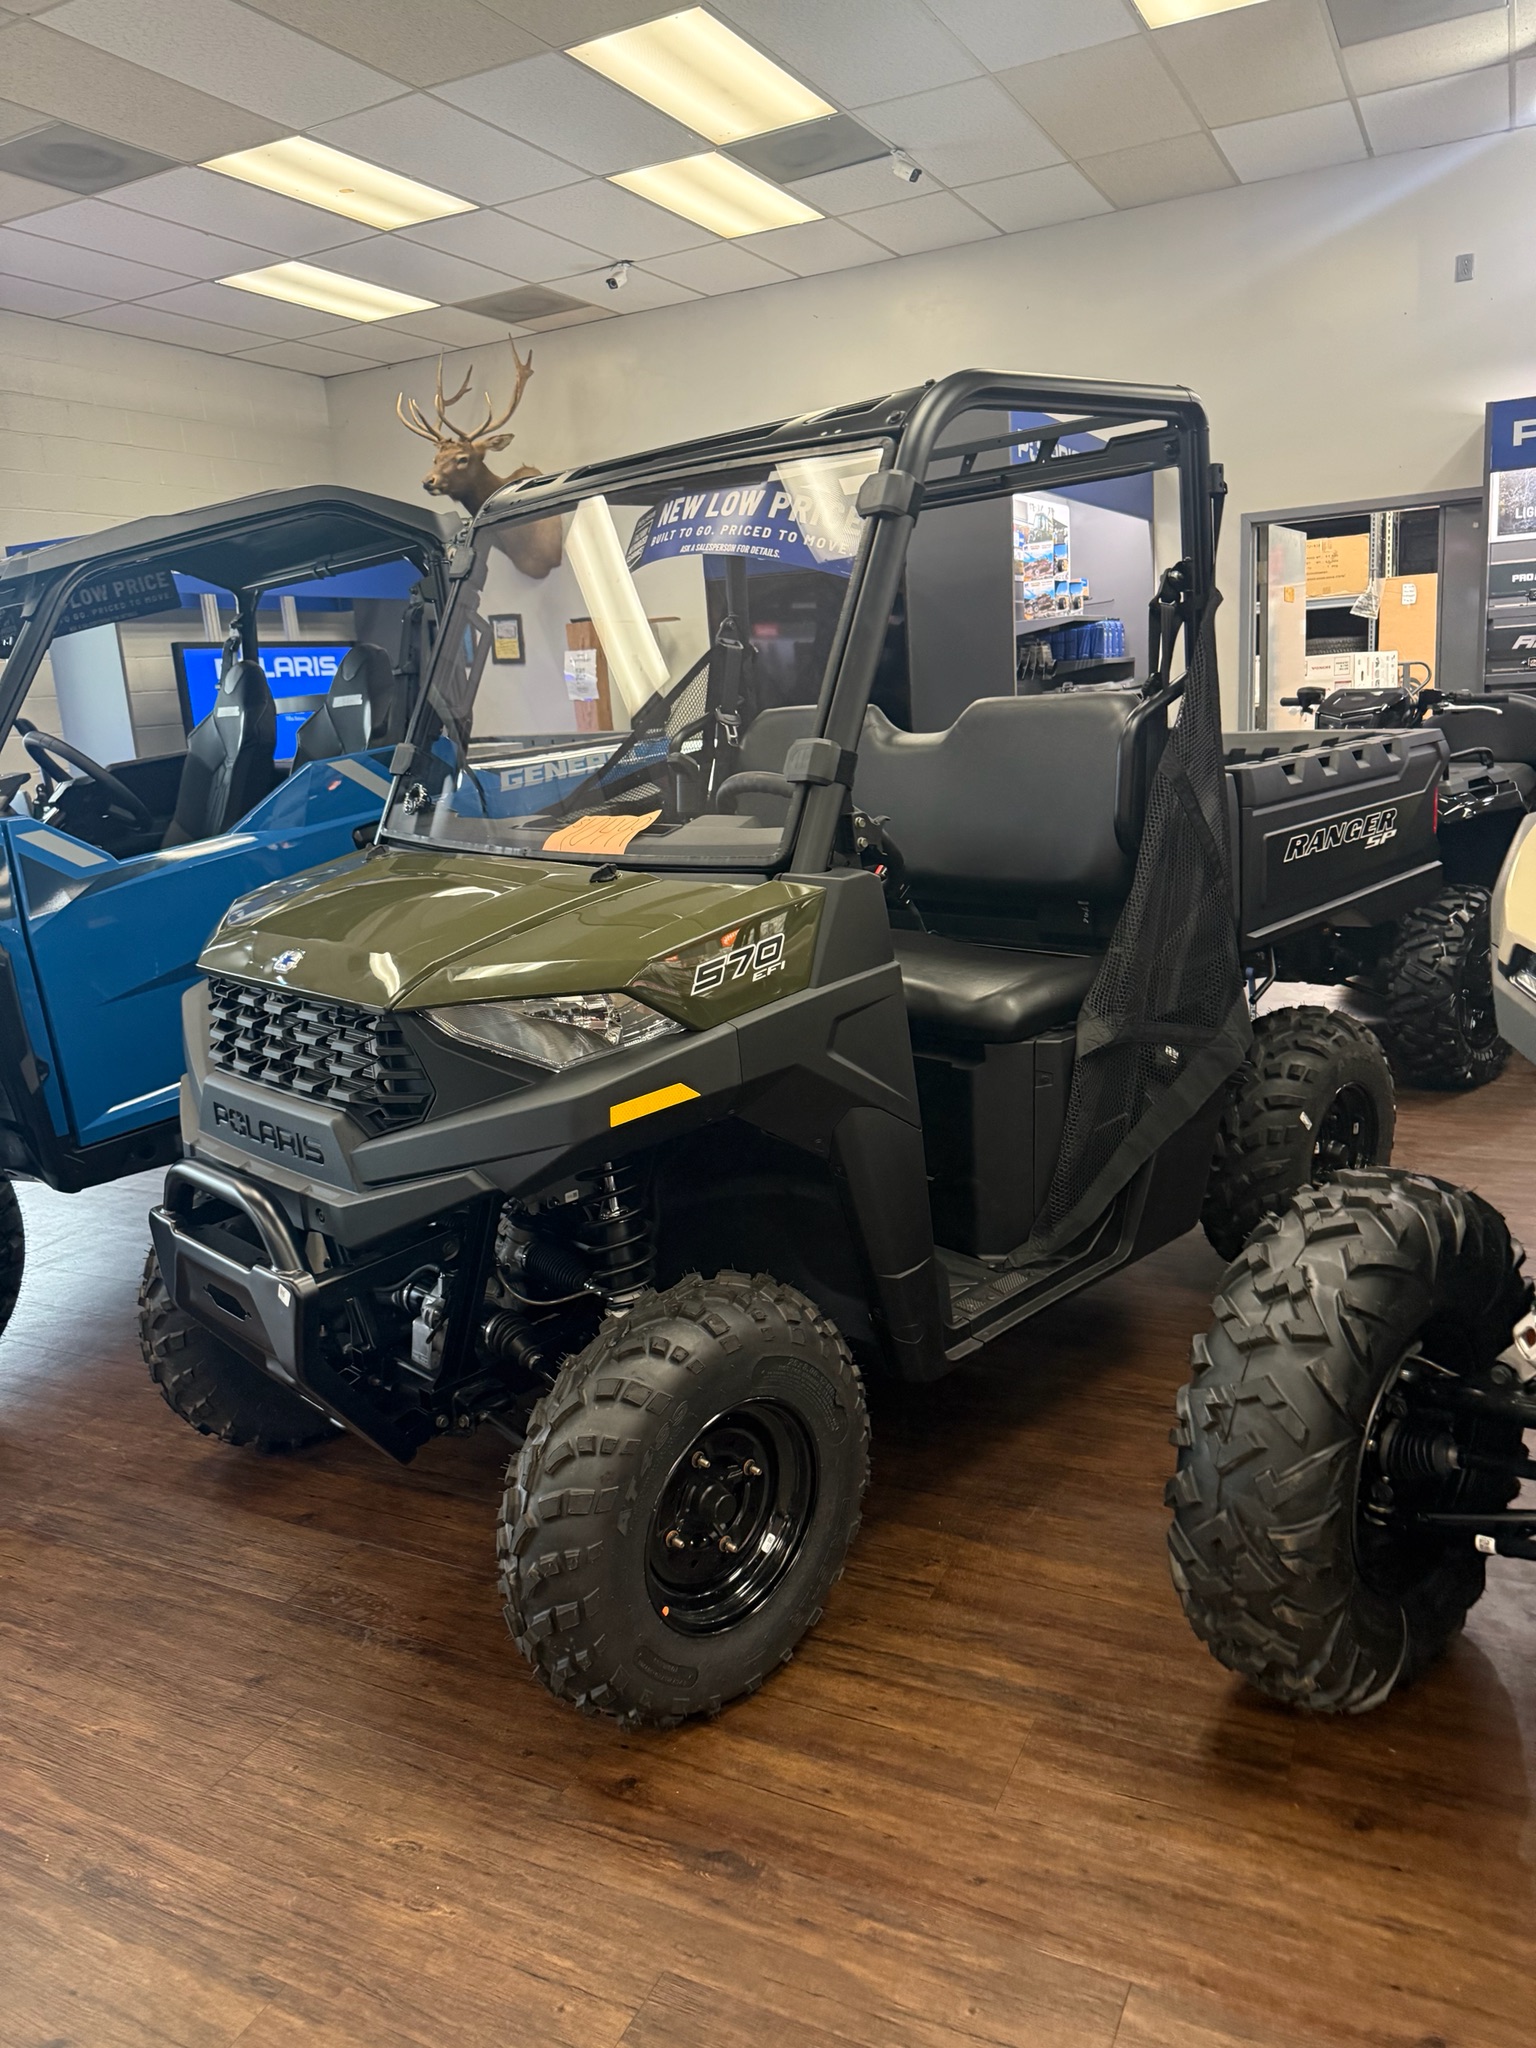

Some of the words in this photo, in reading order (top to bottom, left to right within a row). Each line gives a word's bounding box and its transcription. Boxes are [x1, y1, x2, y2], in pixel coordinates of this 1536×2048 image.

[657, 493, 707, 529] NEW
[705, 489, 767, 518] LOW
[1515, 505, 1536, 519] LIG
[650, 529, 677, 548] BUILT
[680, 526, 693, 539] TO
[696, 525, 715, 537] GO.
[720, 524, 772, 539] PRICED
[779, 529, 798, 543] TO
[803, 534, 853, 557] MOVE.
[680, 544, 692, 553] ASK
[691, 544, 696, 552] A
[695, 543, 737, 553] SALESPERSON
[736, 544, 750, 554] FOR
[750, 546, 780, 559] DETAILS.
[70, 583, 108, 609] LOW
[112, 571, 170, 598] PRICE
[1511, 573, 1536, 583] PRO
[92, 602, 126, 616] PRICED
[130, 598, 141, 607] TO
[1283, 808, 1397, 863] RANGER
[1364, 828, 1397, 849] SP
[690, 933, 785, 996] 570
[752, 960, 785, 982] EFI
[213, 1101, 325, 1166] POLARIS
